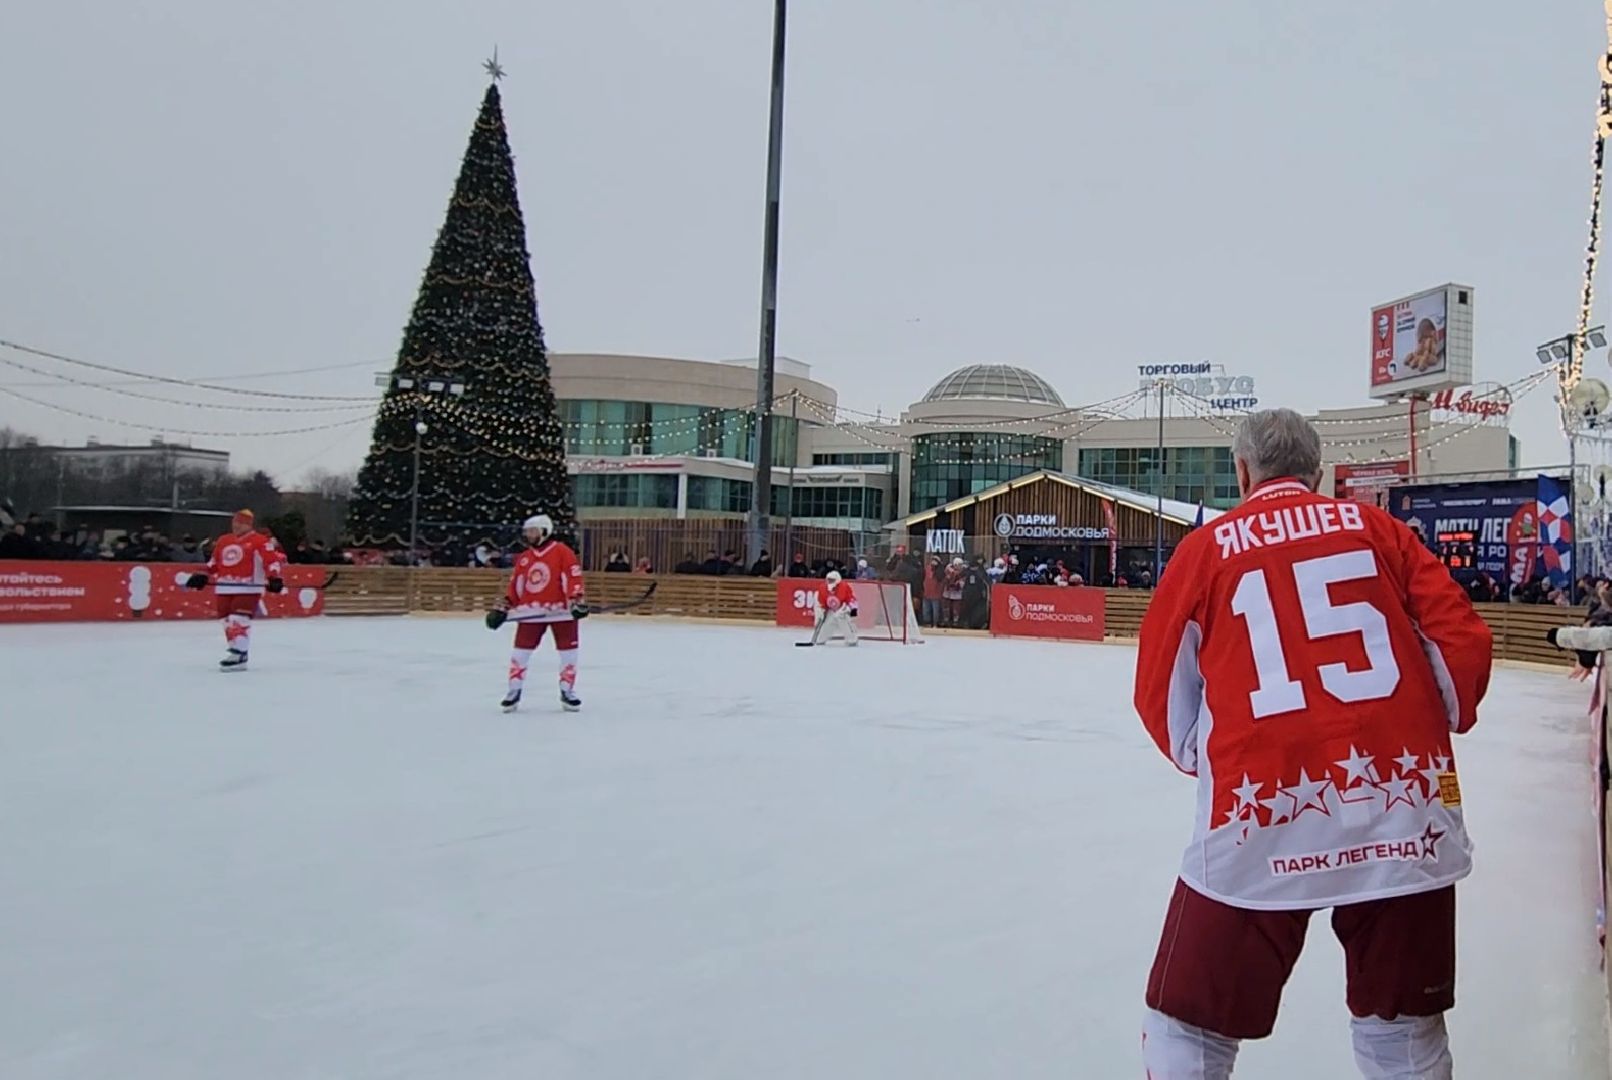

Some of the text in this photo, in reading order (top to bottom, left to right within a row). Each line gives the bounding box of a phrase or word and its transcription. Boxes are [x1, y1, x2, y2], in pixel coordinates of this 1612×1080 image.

[1138, 360, 1211, 376] ТОРГОВЫЙ
[1211, 397, 1258, 413] ЦЕНТР
[1016, 514, 1056, 525] ПАРКИ
[1014, 526, 1110, 539] ПОДМОСКОВЬЯ
[1214, 503, 1364, 559] ЯКУШЕВ
[926, 529, 965, 554] КАТОК
[1027, 603, 1055, 613] ПАРКИ
[1026, 611, 1093, 623] ПОДМОСКОВЬЯ
[1231, 549, 1400, 720] 15
[1273, 841, 1418, 874] ПАРК ЛЕГЕНД
